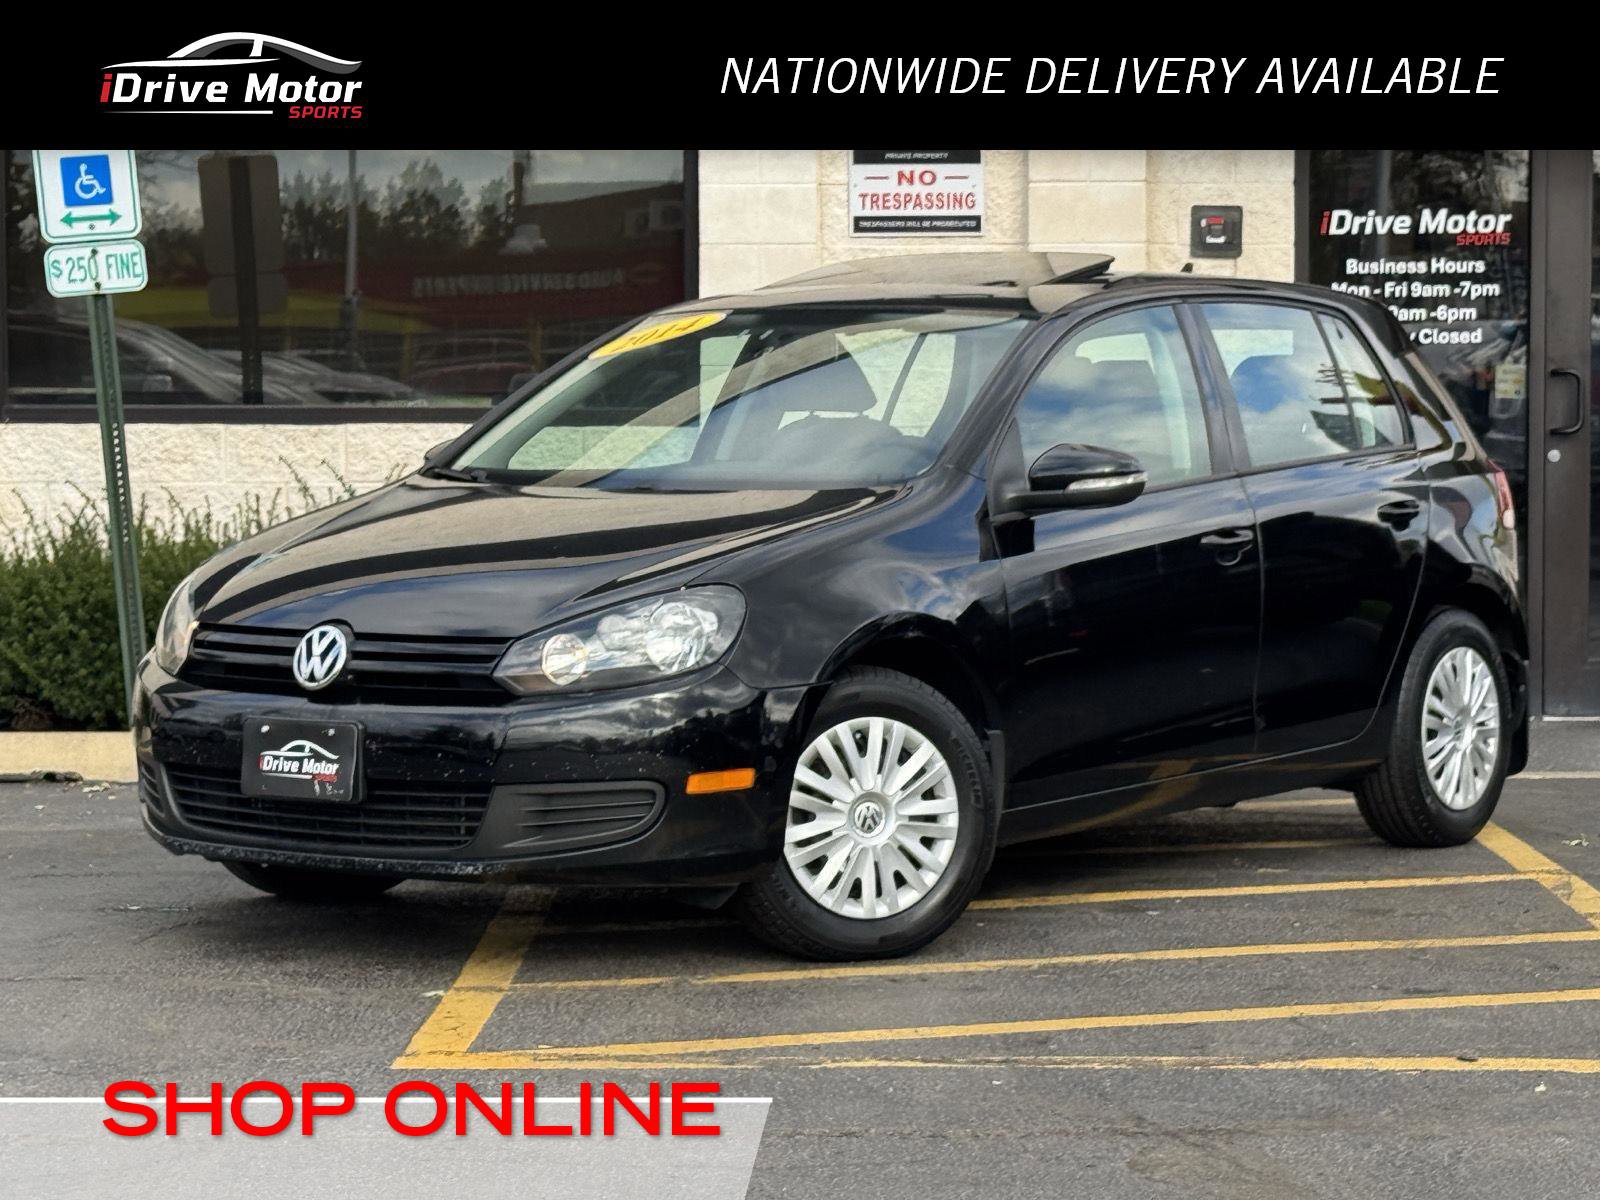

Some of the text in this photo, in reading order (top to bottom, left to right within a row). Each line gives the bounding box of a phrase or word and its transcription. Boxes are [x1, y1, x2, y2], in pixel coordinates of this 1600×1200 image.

[897, 170, 937, 186] NO
[858, 191, 976, 211] TRESPASSING
[1320, 207, 1513, 236] iDrive Motor
[1456, 232, 1511, 246] SPORTS
[105, 252, 144, 281] FINE
[1345, 256, 1486, 275] Business Hours
[1384, 281, 1408, 298] Fri
[1410, 281, 1450, 298] 9am
[1418, 327, 1483, 345] Closed
[301, 758, 340, 775] Motor
